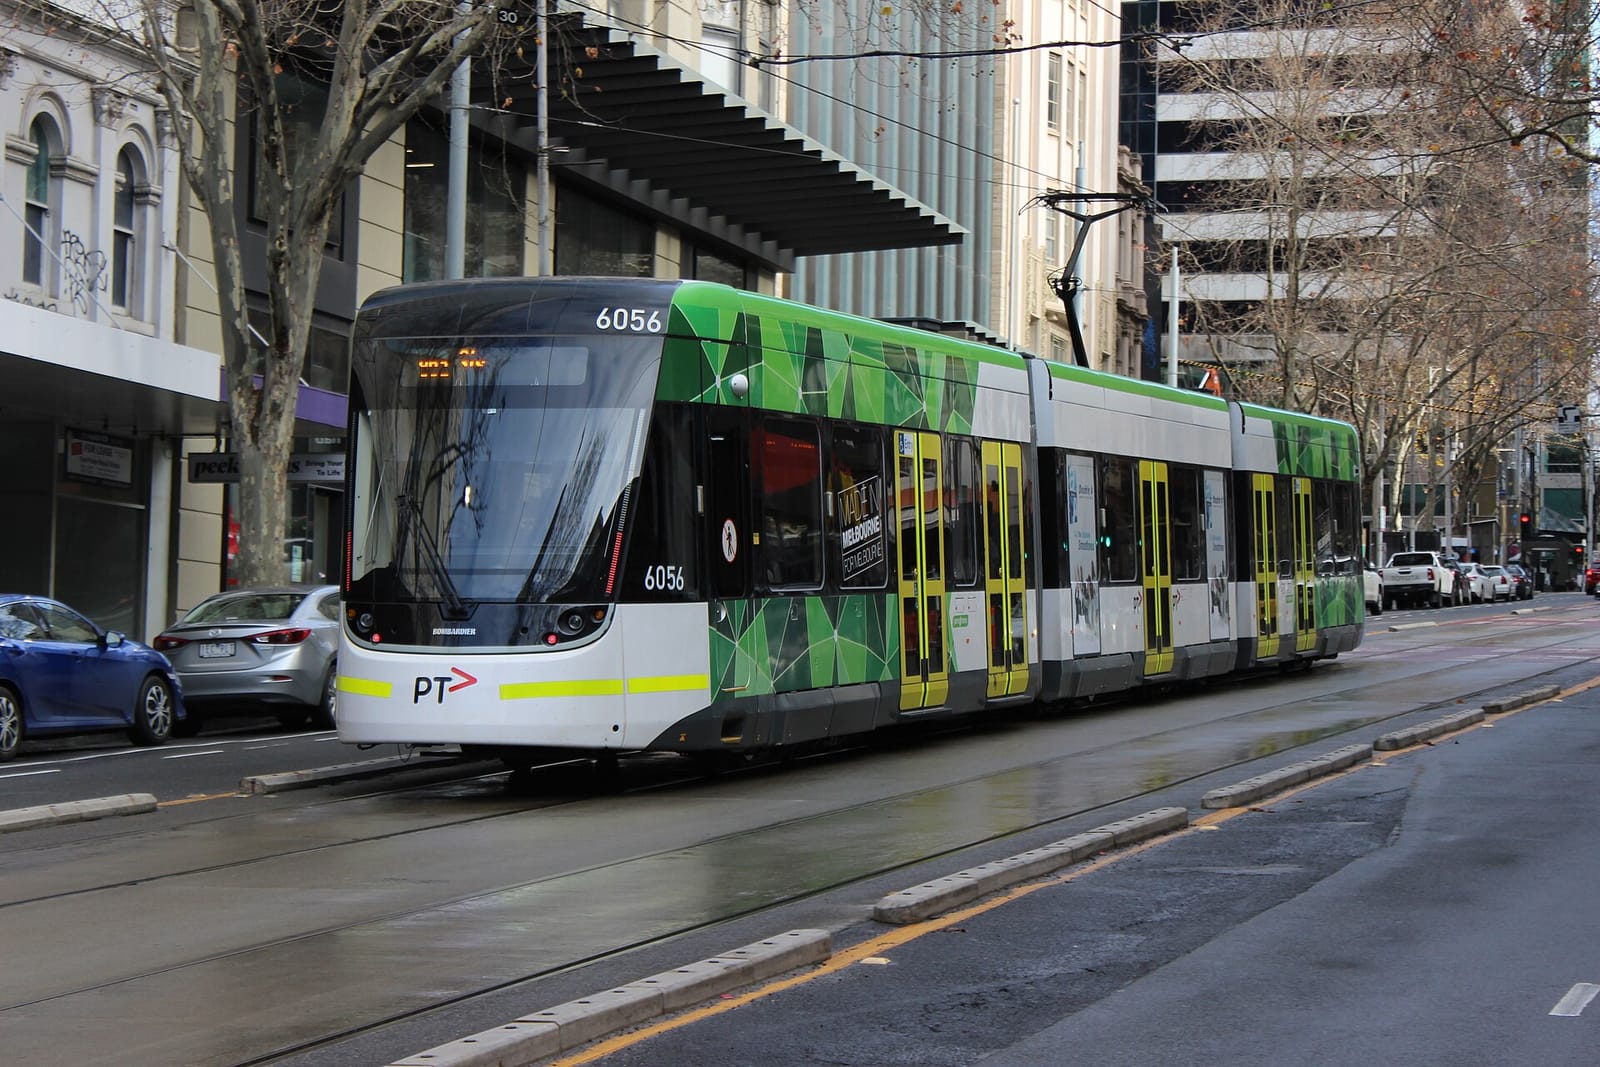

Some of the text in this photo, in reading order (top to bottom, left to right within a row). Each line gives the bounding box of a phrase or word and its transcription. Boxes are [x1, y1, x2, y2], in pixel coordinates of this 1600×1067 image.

[499, 10, 518, 23] 30
[596, 307, 662, 333] 6056
[842, 516, 880, 549] MELBOURNE
[853, 541, 882, 569] MELBOURNE
[644, 565, 684, 591] 6056
[432, 628, 476, 636] BOMBARDIER
